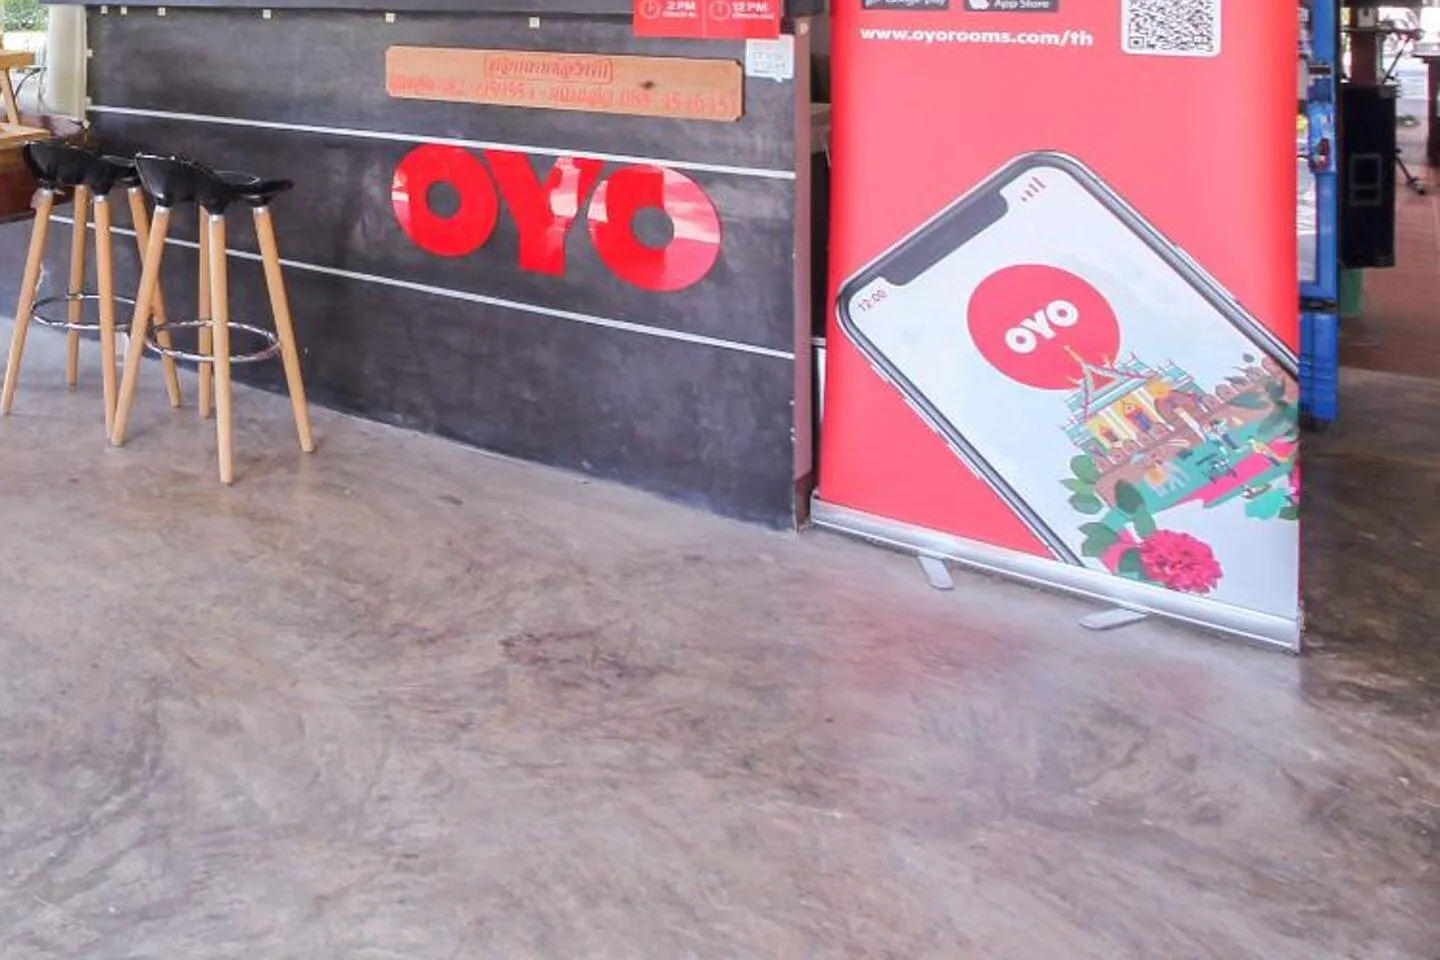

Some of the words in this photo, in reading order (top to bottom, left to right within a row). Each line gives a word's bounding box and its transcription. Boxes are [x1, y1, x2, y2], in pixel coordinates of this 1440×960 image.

[1019, 0, 1050, 8] Store
[860, 26, 1094, 47] www.oyorooms.com/th
[392, 144, 722, 292] OYO
[858, 289, 887, 311] 12:00
[1005, 298, 1079, 354] OYO
